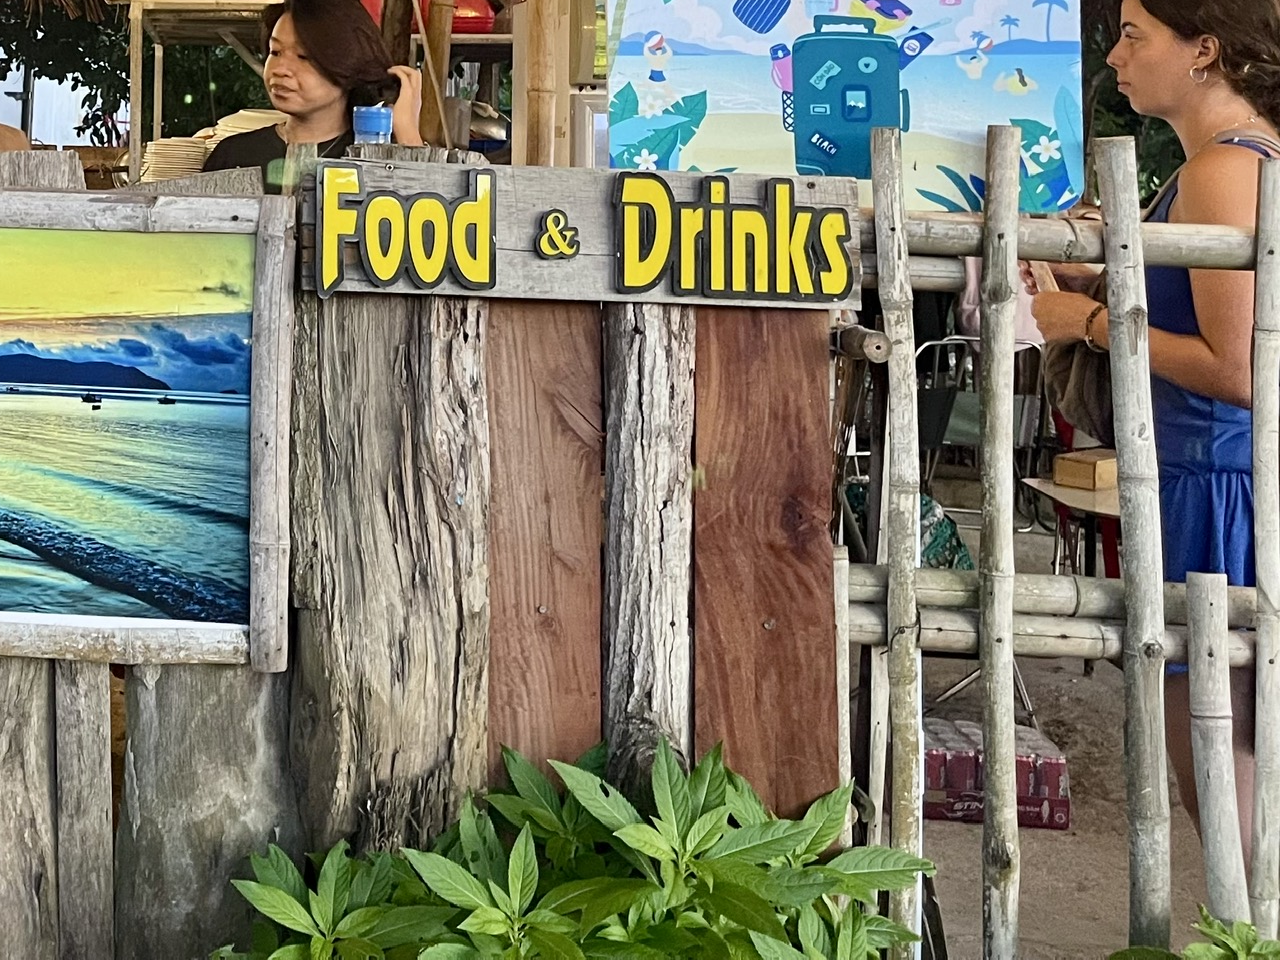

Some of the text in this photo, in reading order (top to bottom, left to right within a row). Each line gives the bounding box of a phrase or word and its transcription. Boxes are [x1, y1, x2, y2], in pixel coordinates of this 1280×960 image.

[811, 133, 837, 155] BEACH
[320, 164, 852, 299] Food & Drinks
